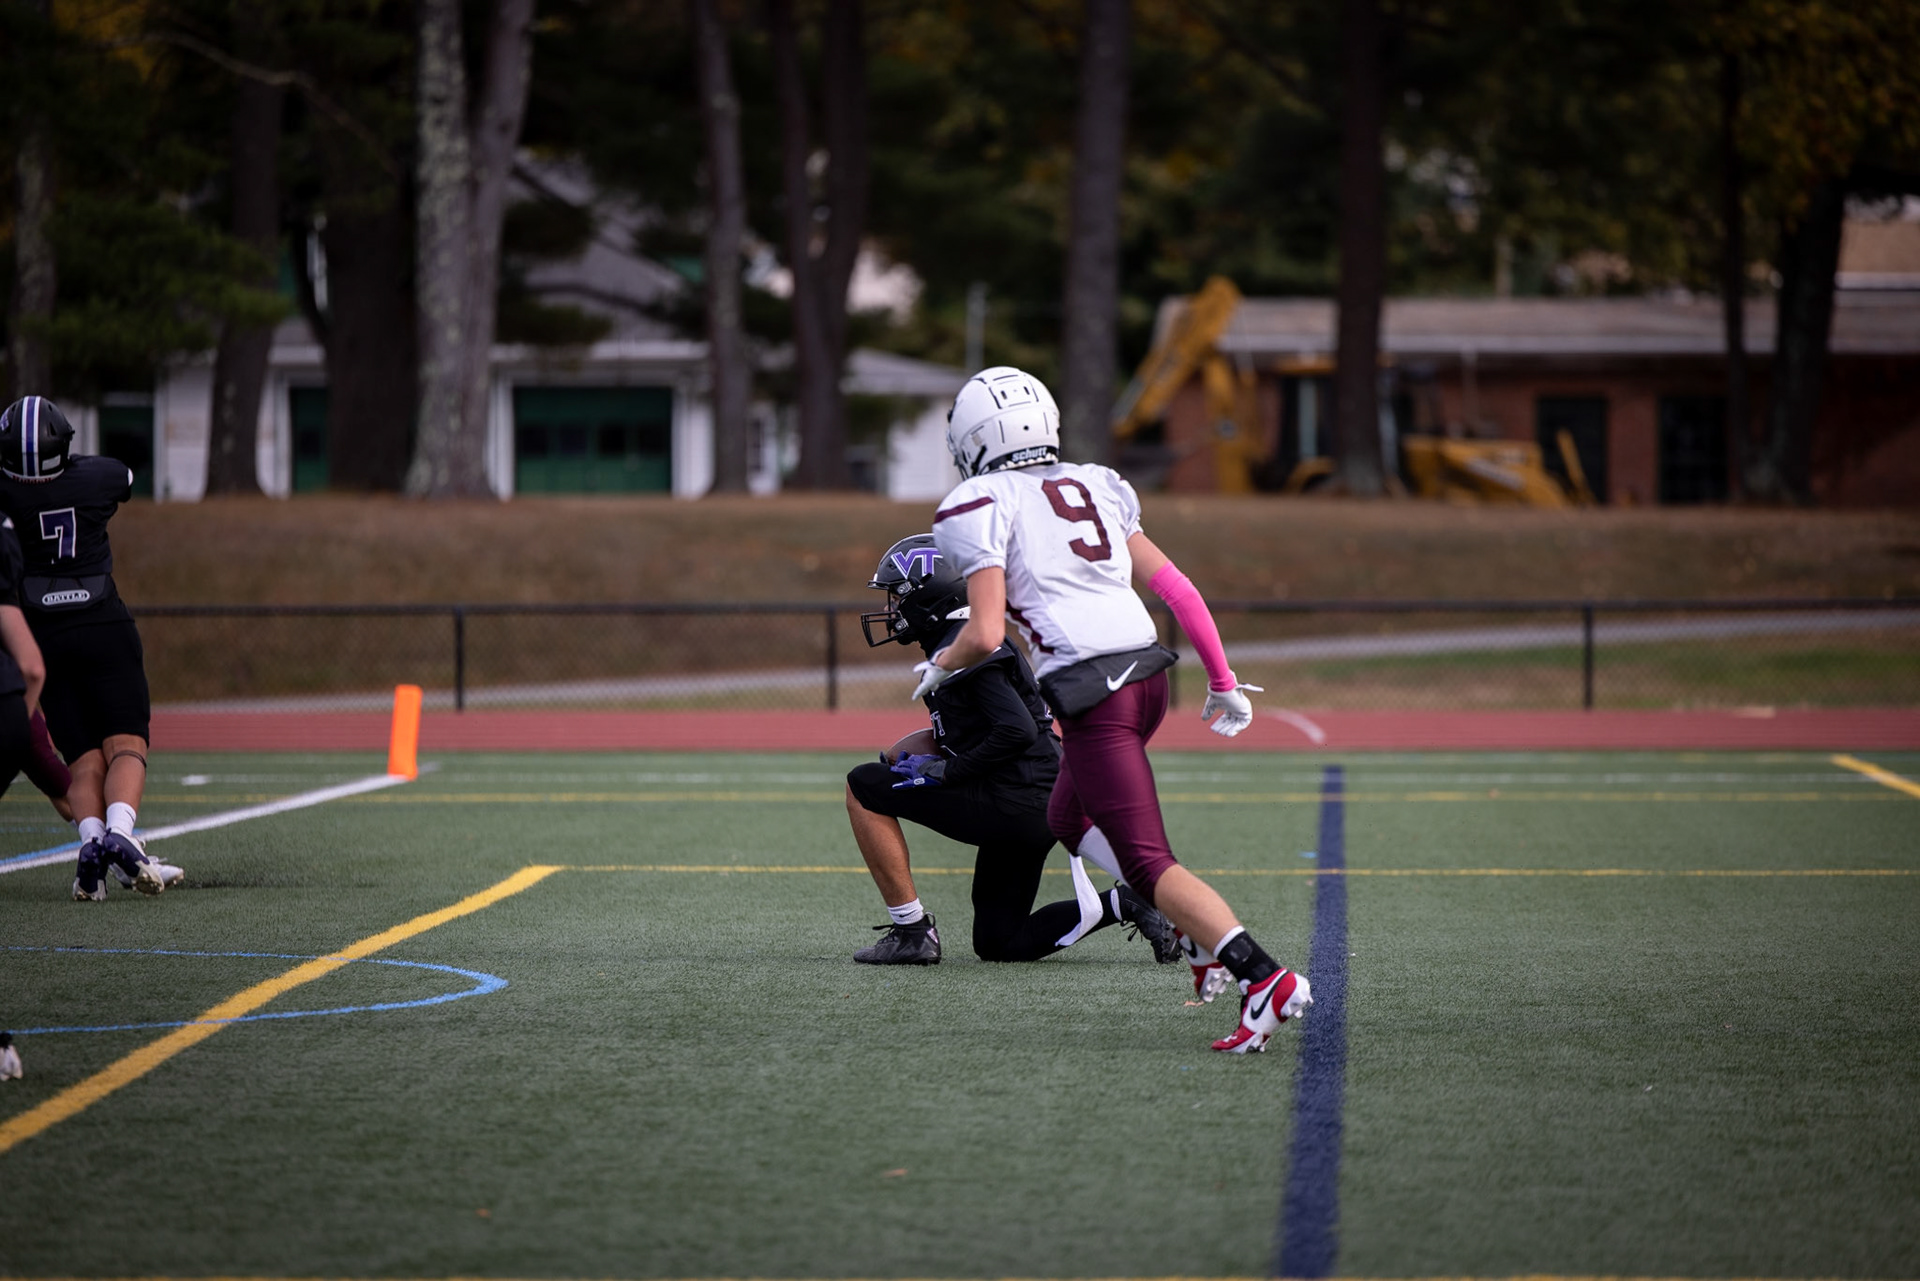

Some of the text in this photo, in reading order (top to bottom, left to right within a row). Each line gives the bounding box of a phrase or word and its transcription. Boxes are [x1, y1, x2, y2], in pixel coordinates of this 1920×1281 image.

[1012, 447, 1048, 462] schutt
[39, 507, 76, 560] 7
[1041, 477, 1111, 562] 9
[890, 547, 943, 579] VT
